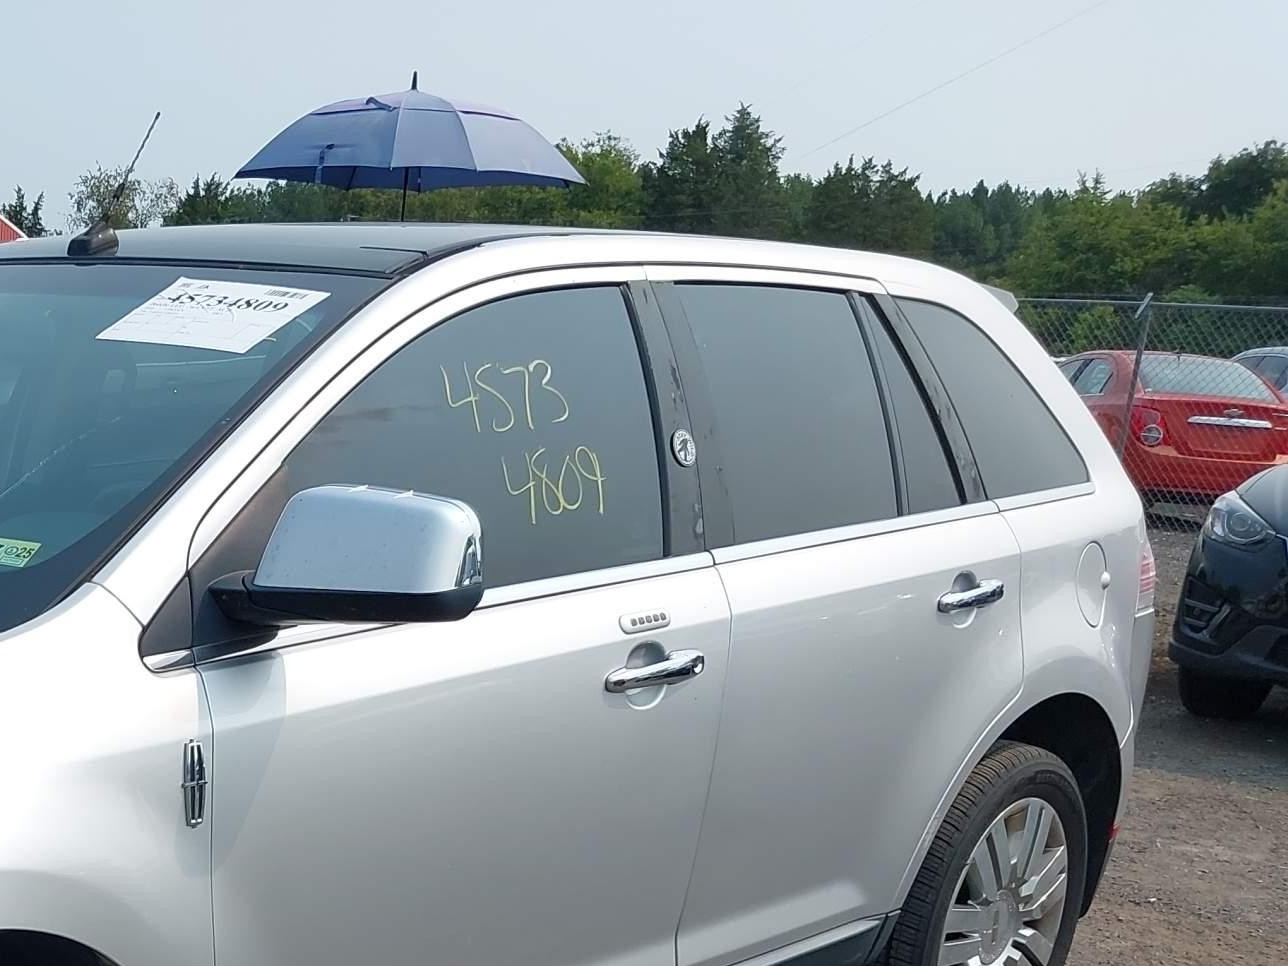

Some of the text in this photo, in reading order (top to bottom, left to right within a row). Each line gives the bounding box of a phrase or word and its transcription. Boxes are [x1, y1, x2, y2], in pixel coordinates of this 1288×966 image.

[167, 293, 289, 313] 45734809
[439, 359, 570, 432] 4573
[500, 446, 607, 525] 4809
[15, 546, 36, 559] 25
